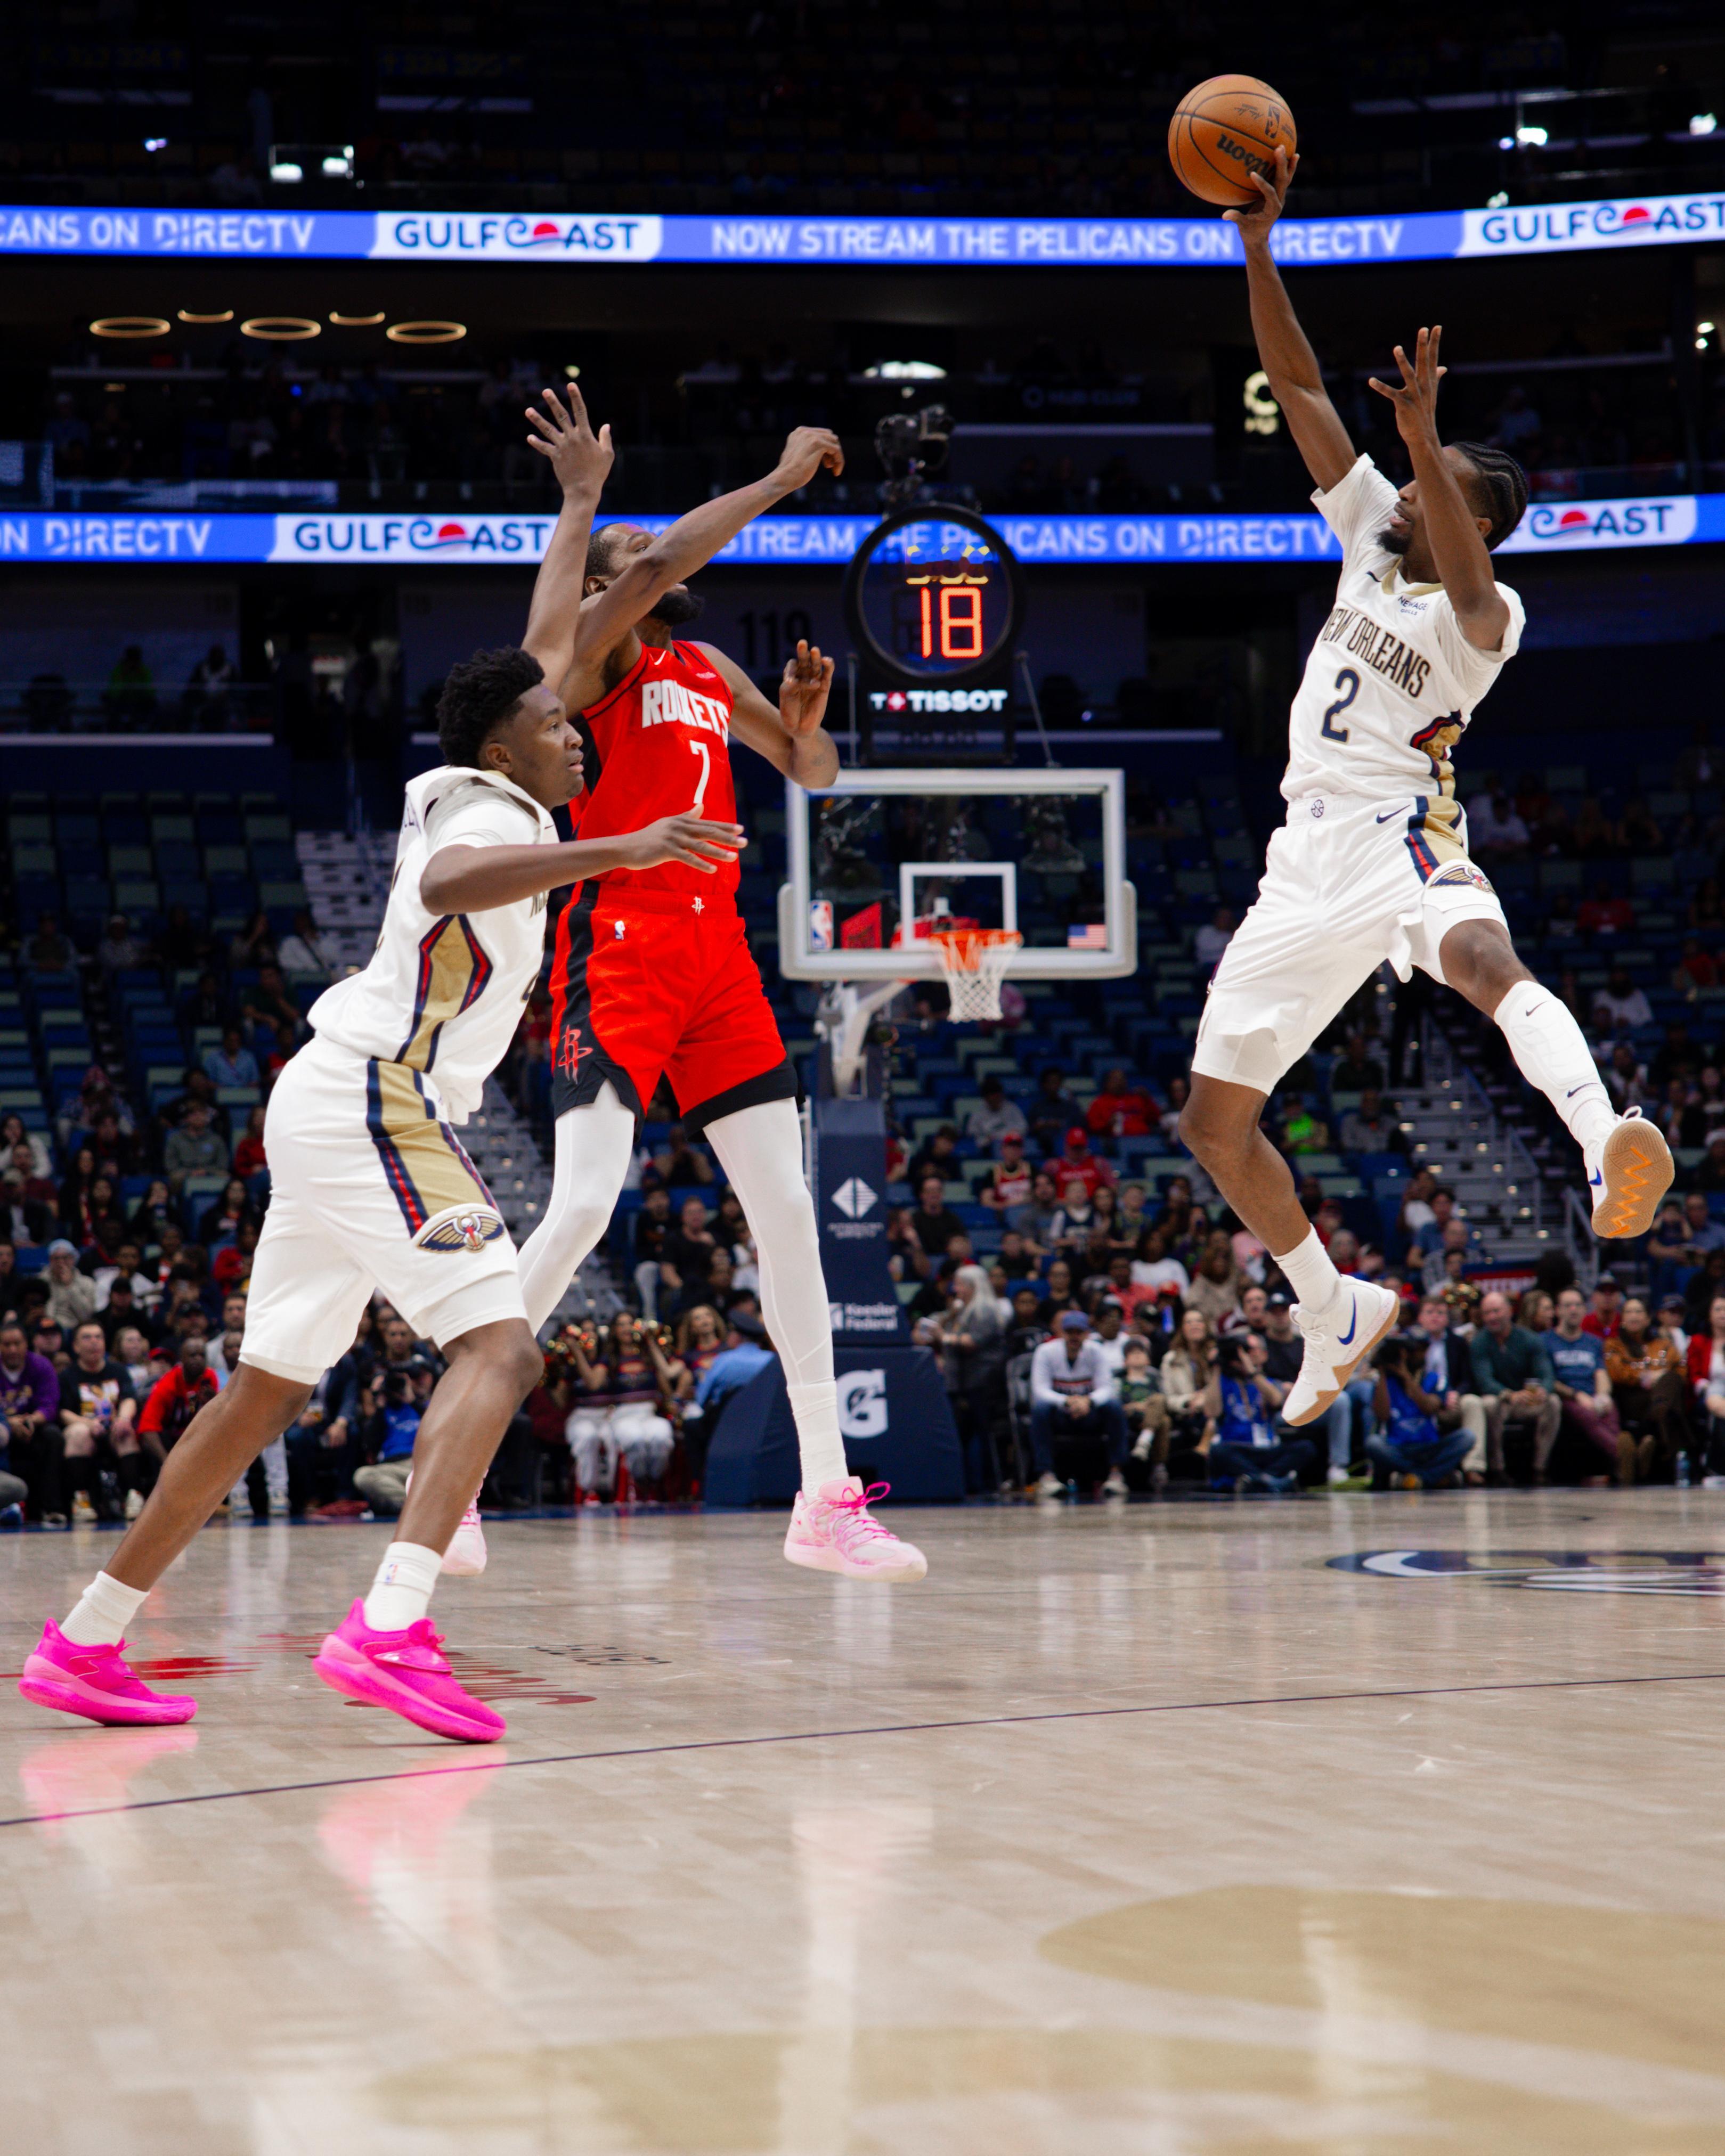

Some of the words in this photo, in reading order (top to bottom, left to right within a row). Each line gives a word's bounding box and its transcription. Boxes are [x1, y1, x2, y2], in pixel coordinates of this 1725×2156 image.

[1216, 133, 1276, 180] ilson
[89, 214, 138, 247] ON
[154, 215, 315, 252] DIRECTV
[711, 224, 793, 256] NOW
[799, 225, 936, 257] STREAM
[943, 225, 1008, 258] THE
[1016, 225, 1176, 258] PELICANS
[1185, 225, 1231, 258] ON
[1272, 220, 1403, 258] IRECTV
[0, 519, 29, 554] N
[44, 519, 211, 556] DIRECTV
[1115, 522, 1165, 556] ON
[1178, 520, 1332, 557] DIRECTV
[920, 586, 983, 659] 18
[1347, 616, 1432, 699] ORLEANS
[907, 690, 1008, 712] TISSOT
[1320, 666, 1362, 744] 2
[689, 739, 711, 804] 7
